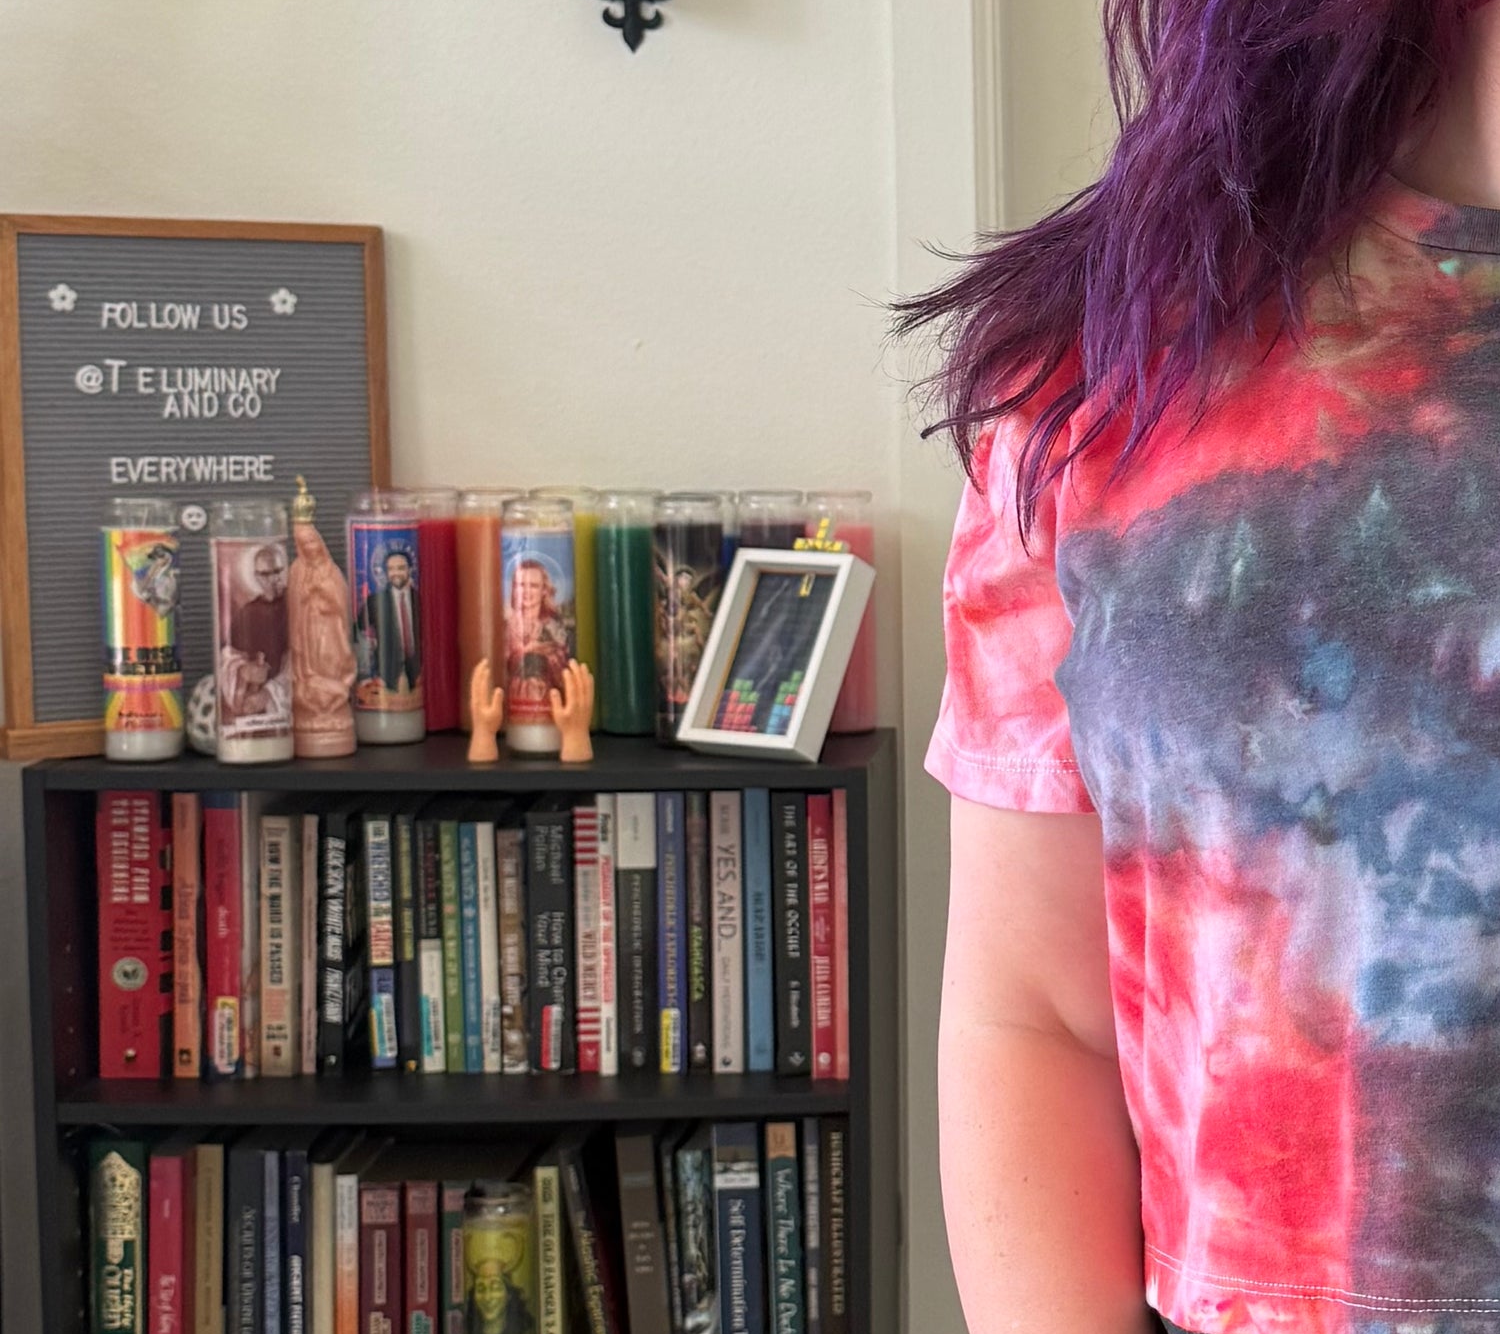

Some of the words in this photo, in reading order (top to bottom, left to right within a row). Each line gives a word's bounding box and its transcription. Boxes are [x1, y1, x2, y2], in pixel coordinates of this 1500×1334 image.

[101, 302, 200, 330] FOLLOW
[213, 305, 249, 331] US
[163, 393, 219, 418] AND
[227, 394, 262, 418] CO
[110, 455, 275, 483] EVERYWHERE
[783, 805, 797, 827] THE
[534, 824, 549, 872] Pollan
[550, 824, 565, 885] Michael
[785, 831, 798, 856] ART
[716, 843, 738, 887] YES,
[786, 860, 799, 877] OF
[786, 882, 799, 906] THE
[535, 911, 551, 946] Your
[551, 911, 565, 945] How
[787, 909, 800, 959] OCCULT
[551, 948, 566, 964] to
[582, 929, 597, 959] WILD
[536, 949, 551, 988] Mind
[830, 1131, 844, 1215] BUSHCRAFT
[774, 1166, 795, 1213] Where
[542, 1212, 556, 1237] THE
[728, 1198, 748, 1223] Self
[775, 1215, 796, 1254] There
[543, 1238, 556, 1264] OLD
[729, 1228, 749, 1329] Determination
[831, 1217, 845, 1316] ILLUSTRATED
[777, 1277, 796, 1298] No
